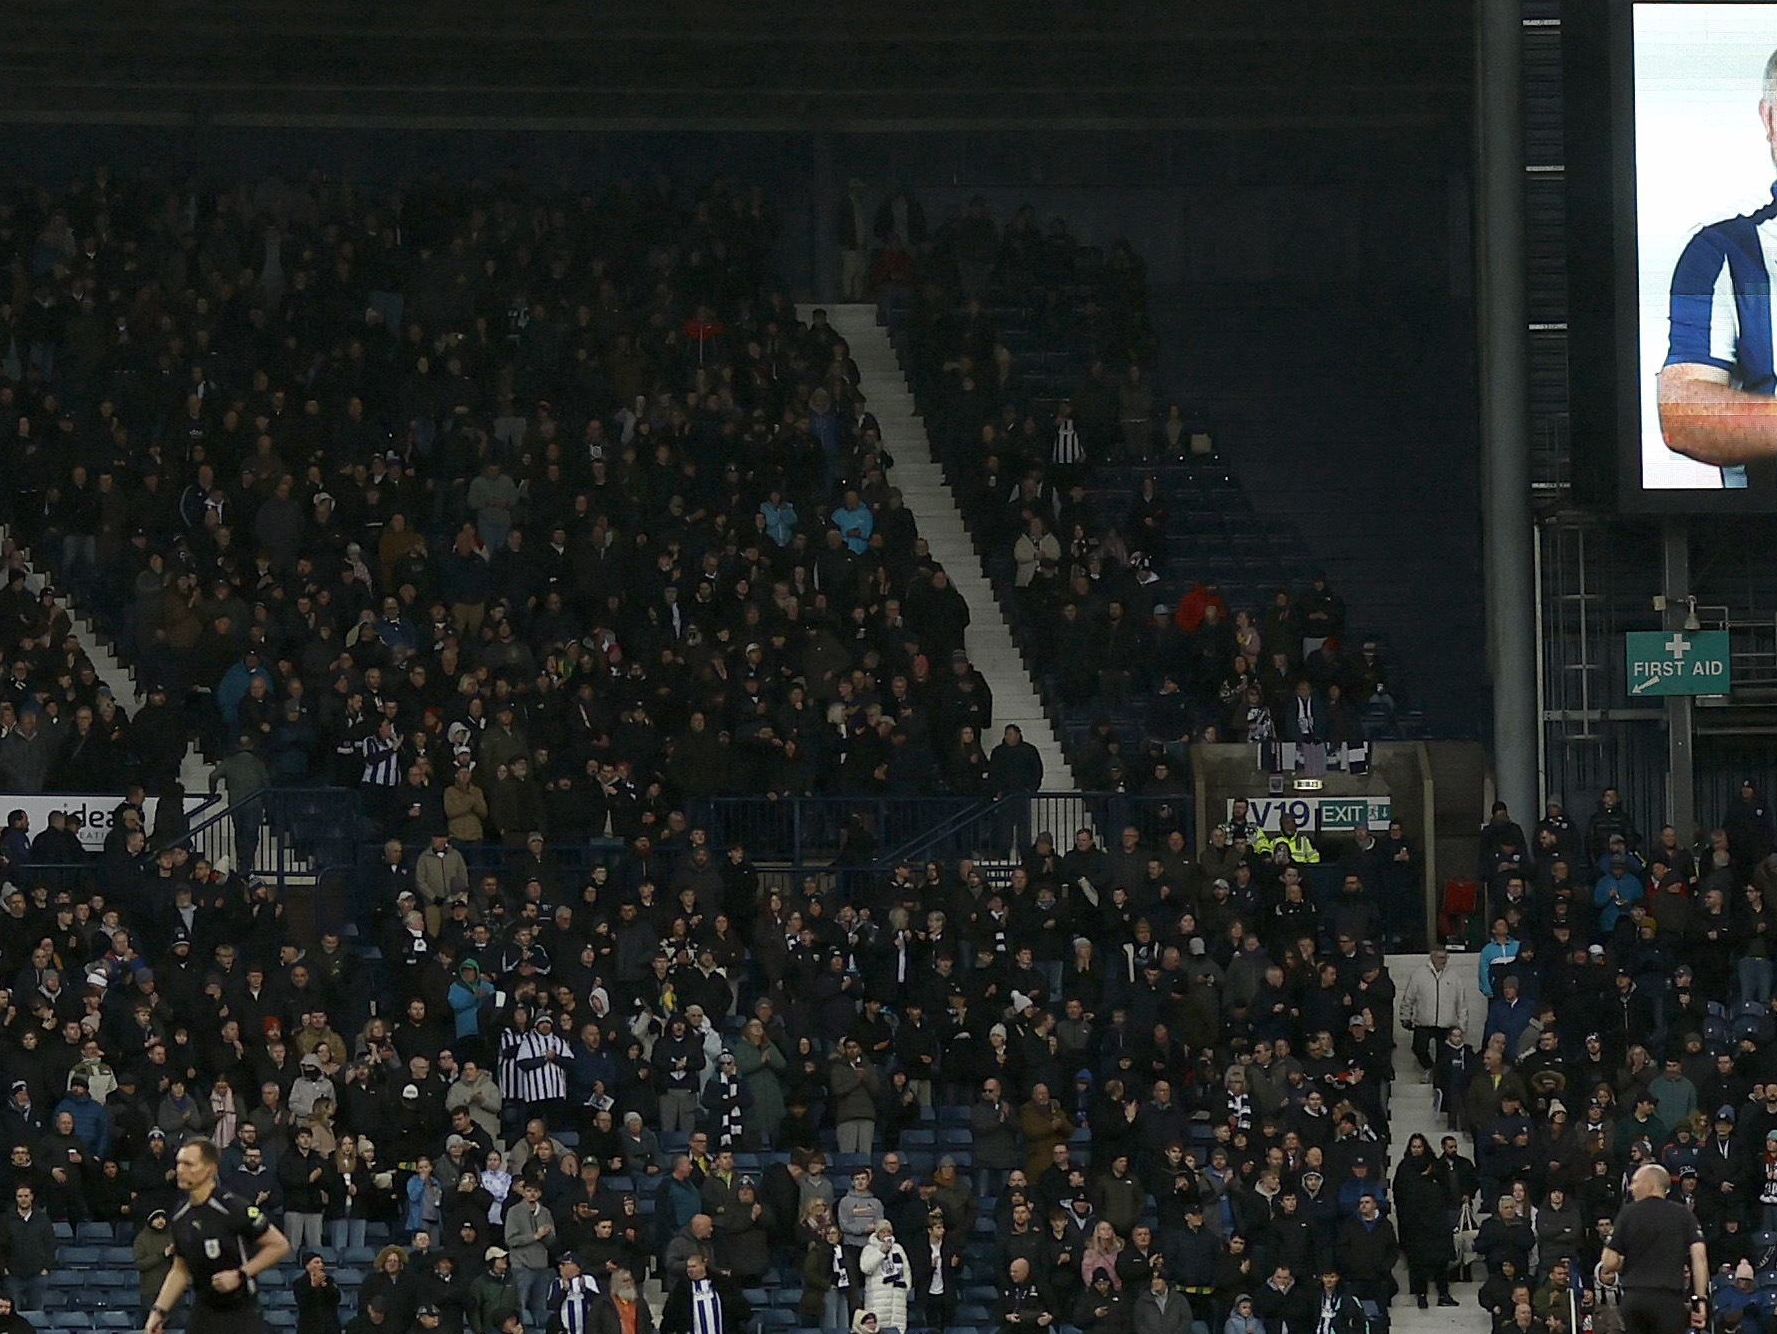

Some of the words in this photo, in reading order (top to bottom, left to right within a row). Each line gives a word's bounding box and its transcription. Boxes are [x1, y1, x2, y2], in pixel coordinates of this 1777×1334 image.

[1633, 660, 1686, 678] FIRST
[1692, 660, 1724, 676] AID
[1322, 805, 1365, 823] EXIT
